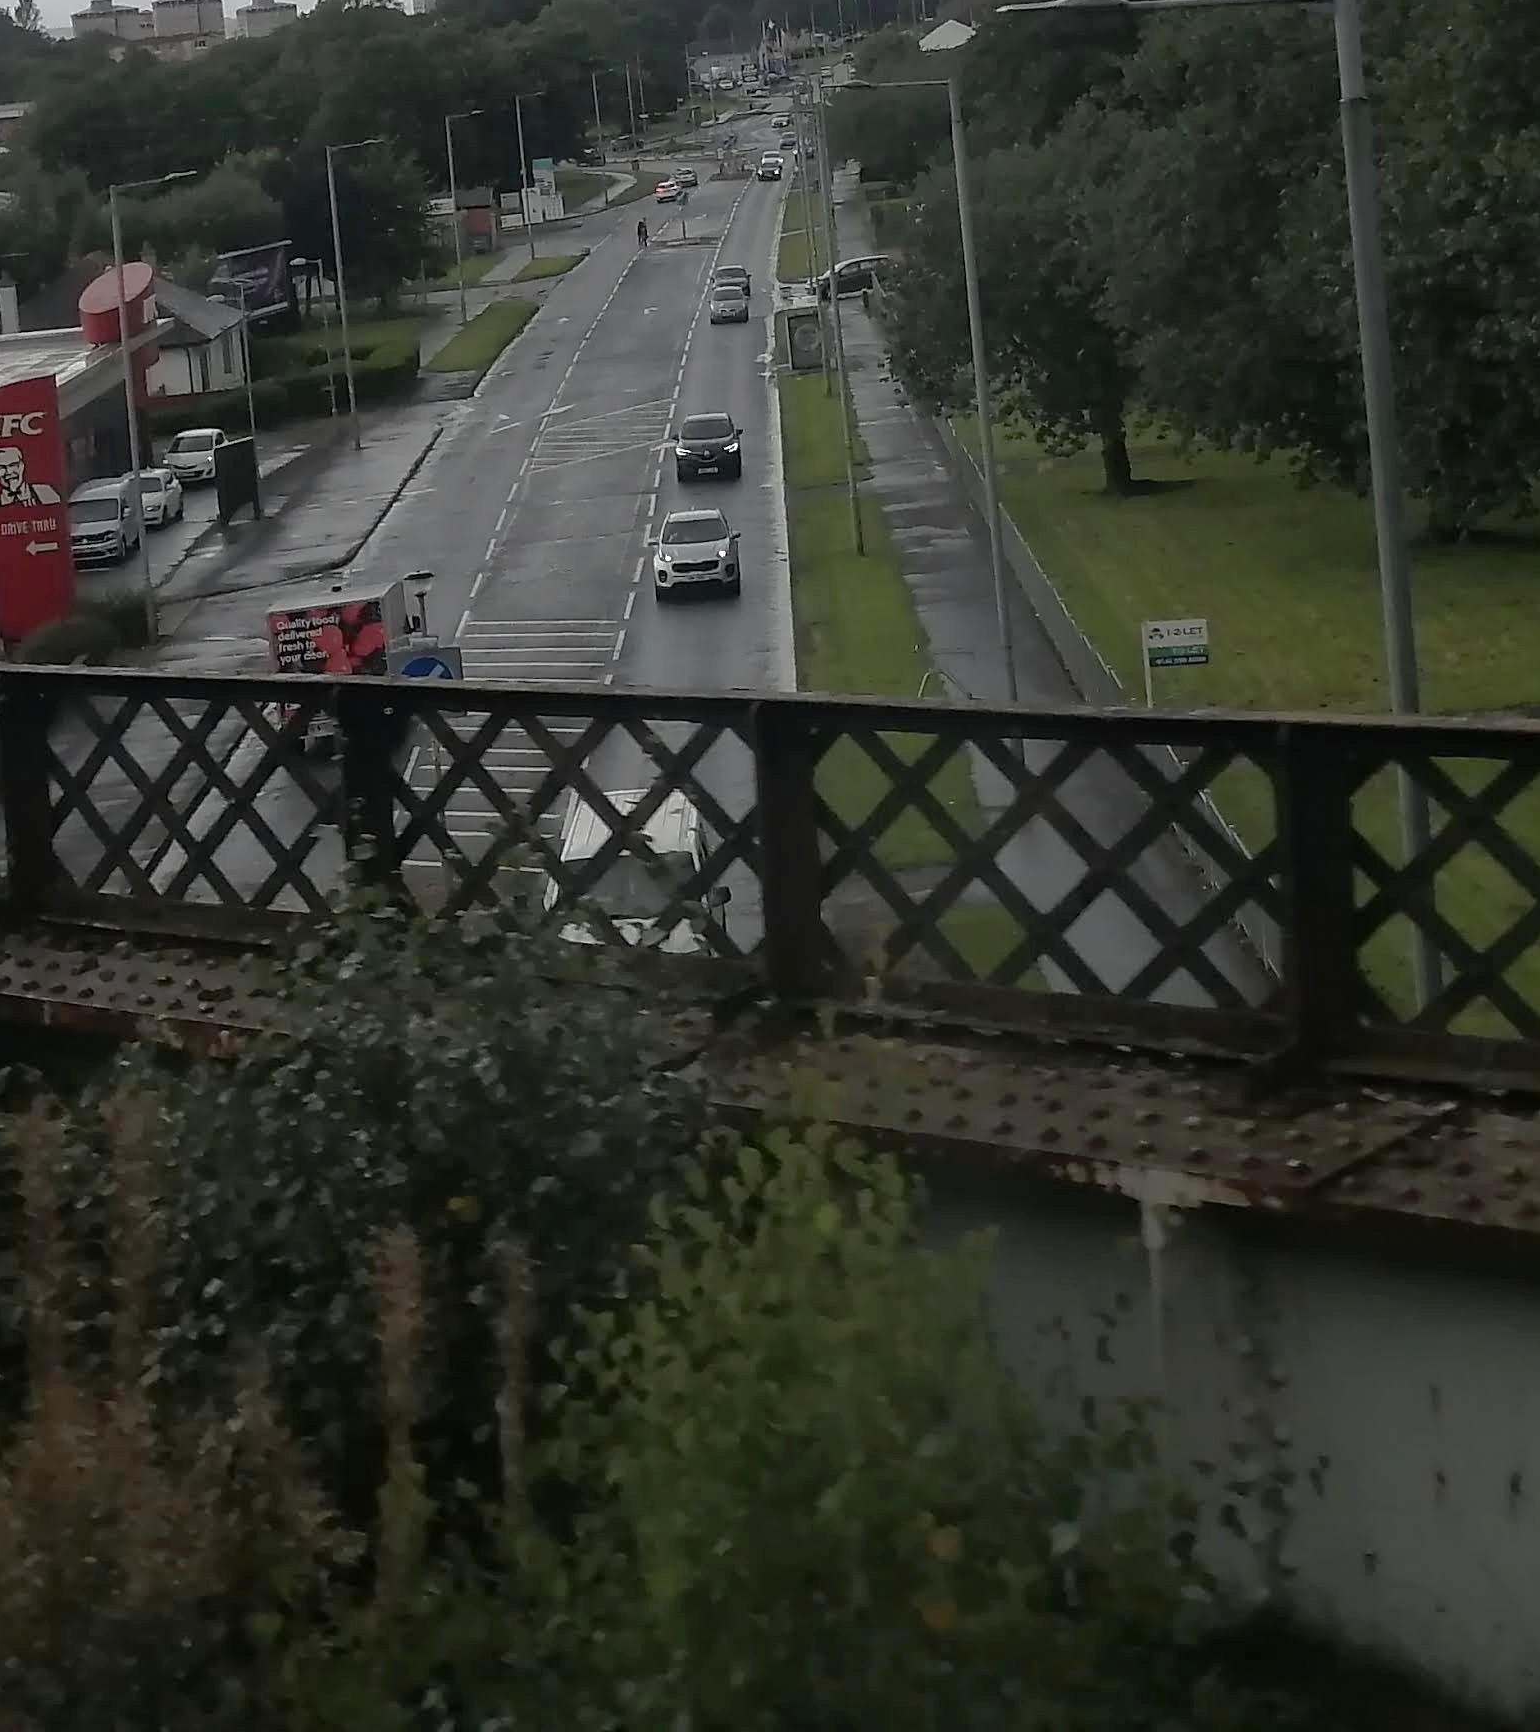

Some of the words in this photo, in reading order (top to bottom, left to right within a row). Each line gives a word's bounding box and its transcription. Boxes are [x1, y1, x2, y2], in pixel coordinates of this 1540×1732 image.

[0, 521, 29, 535] DRIVE
[32, 517, 56, 532] THRU
[276, 618, 310, 630] Quality
[277, 627, 323, 641] delivered
[279, 641, 304, 653] fresh
[305, 641, 316, 650] to
[280, 655, 302, 666] your
